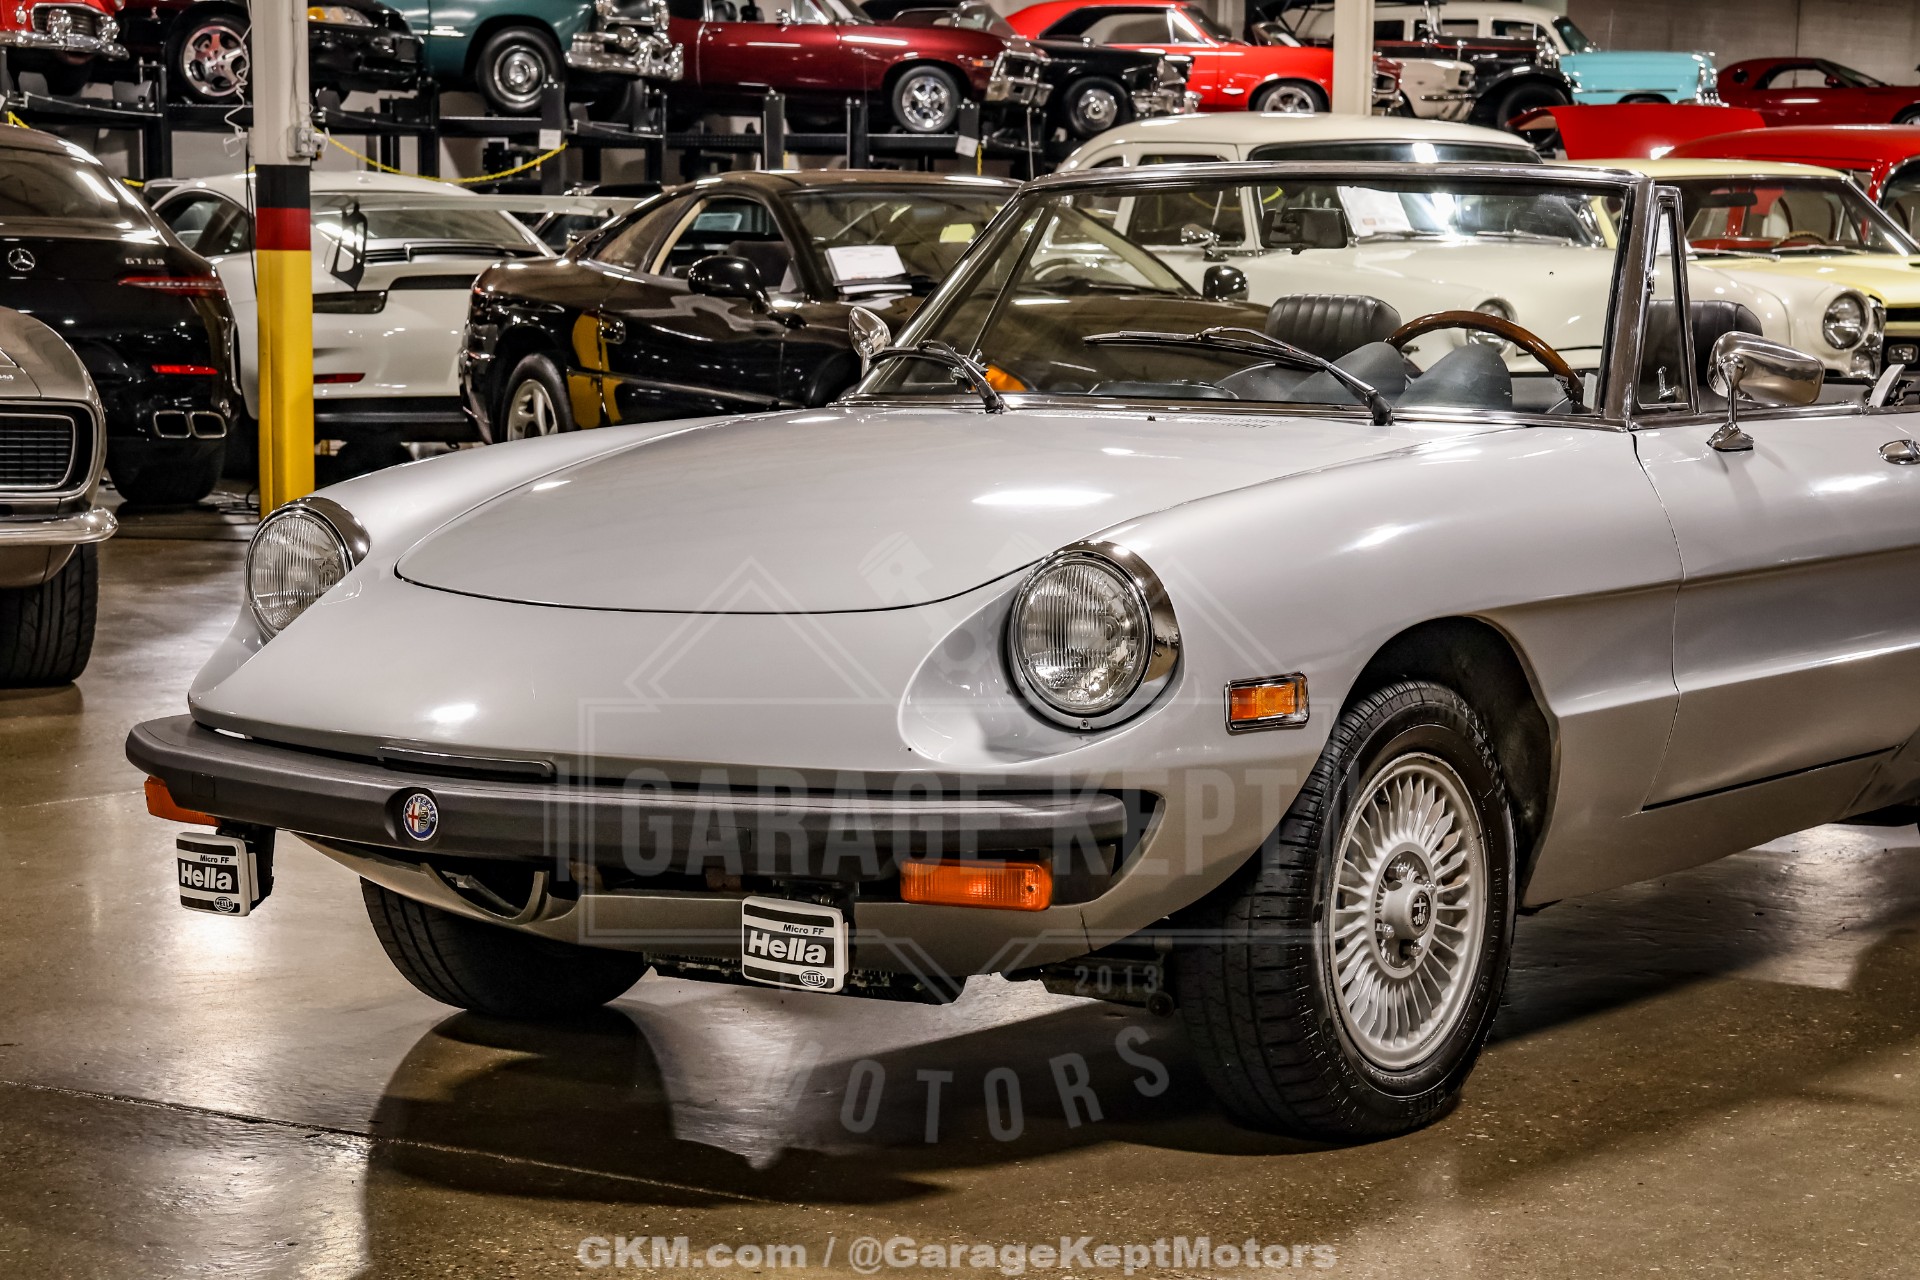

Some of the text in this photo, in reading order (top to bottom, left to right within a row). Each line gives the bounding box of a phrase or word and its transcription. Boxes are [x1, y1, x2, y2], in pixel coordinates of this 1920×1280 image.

[199, 854, 218, 864] Micro
[180, 862, 232, 891] Hella
[783, 924, 825, 936] Micro FF
[748, 930, 827, 964] Hella
[802, 973, 826, 984] HELLA
